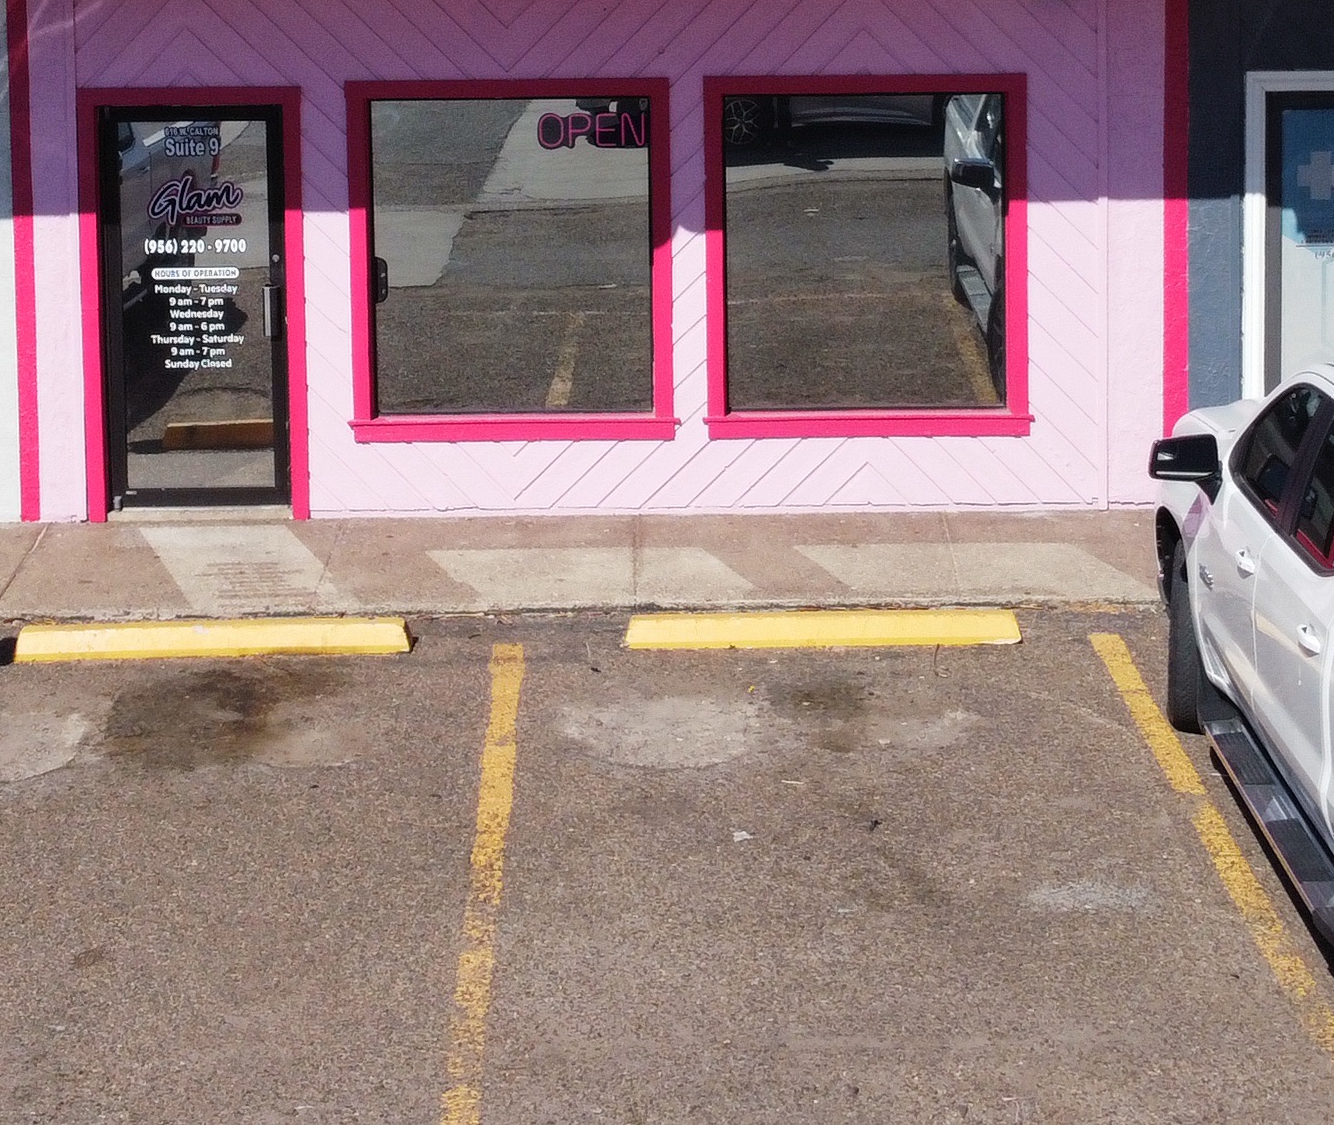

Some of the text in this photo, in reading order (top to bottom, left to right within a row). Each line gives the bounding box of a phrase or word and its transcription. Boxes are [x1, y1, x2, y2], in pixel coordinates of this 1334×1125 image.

[537, 113, 646, 150] OPEN
[165, 137, 219, 156] Suite 9
[149, 175, 242, 225] Glam
[185, 216, 210, 224] BEAUTY
[145, 238, 247, 255] (956) 220 9700
[155, 284, 238, 296] Monday Tuesday
[177, 298, 193, 306] am
[208, 298, 224, 307] pm
[169, 309, 224, 320] Wednesday
[209, 324, 225, 333] pm
[150, 333, 244, 346] Thursday Saturday
[209, 348, 226, 358] pm
[165, 358, 233, 370] Sunday Closed
